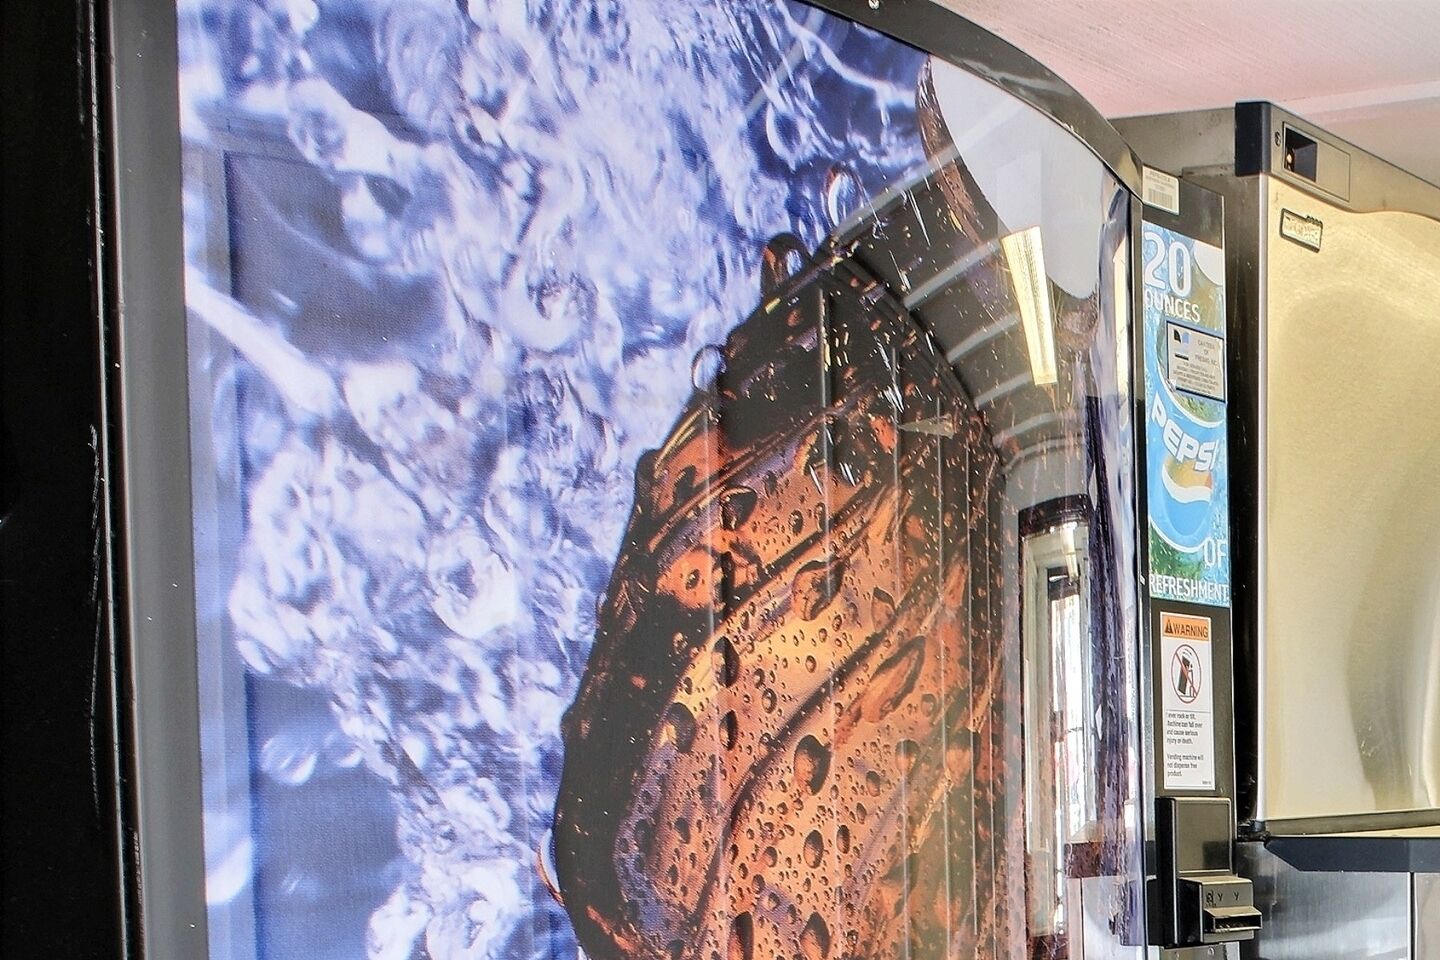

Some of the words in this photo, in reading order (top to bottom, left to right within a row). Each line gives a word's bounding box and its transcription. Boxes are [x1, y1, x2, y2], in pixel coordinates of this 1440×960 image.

[1144, 231, 1191, 298] 20
[1144, 289, 1200, 324] OUNCES
[1152, 392, 1219, 471] PEPSI
[1203, 537, 1227, 568] OF
[1173, 622, 1209, 639] WARNING
